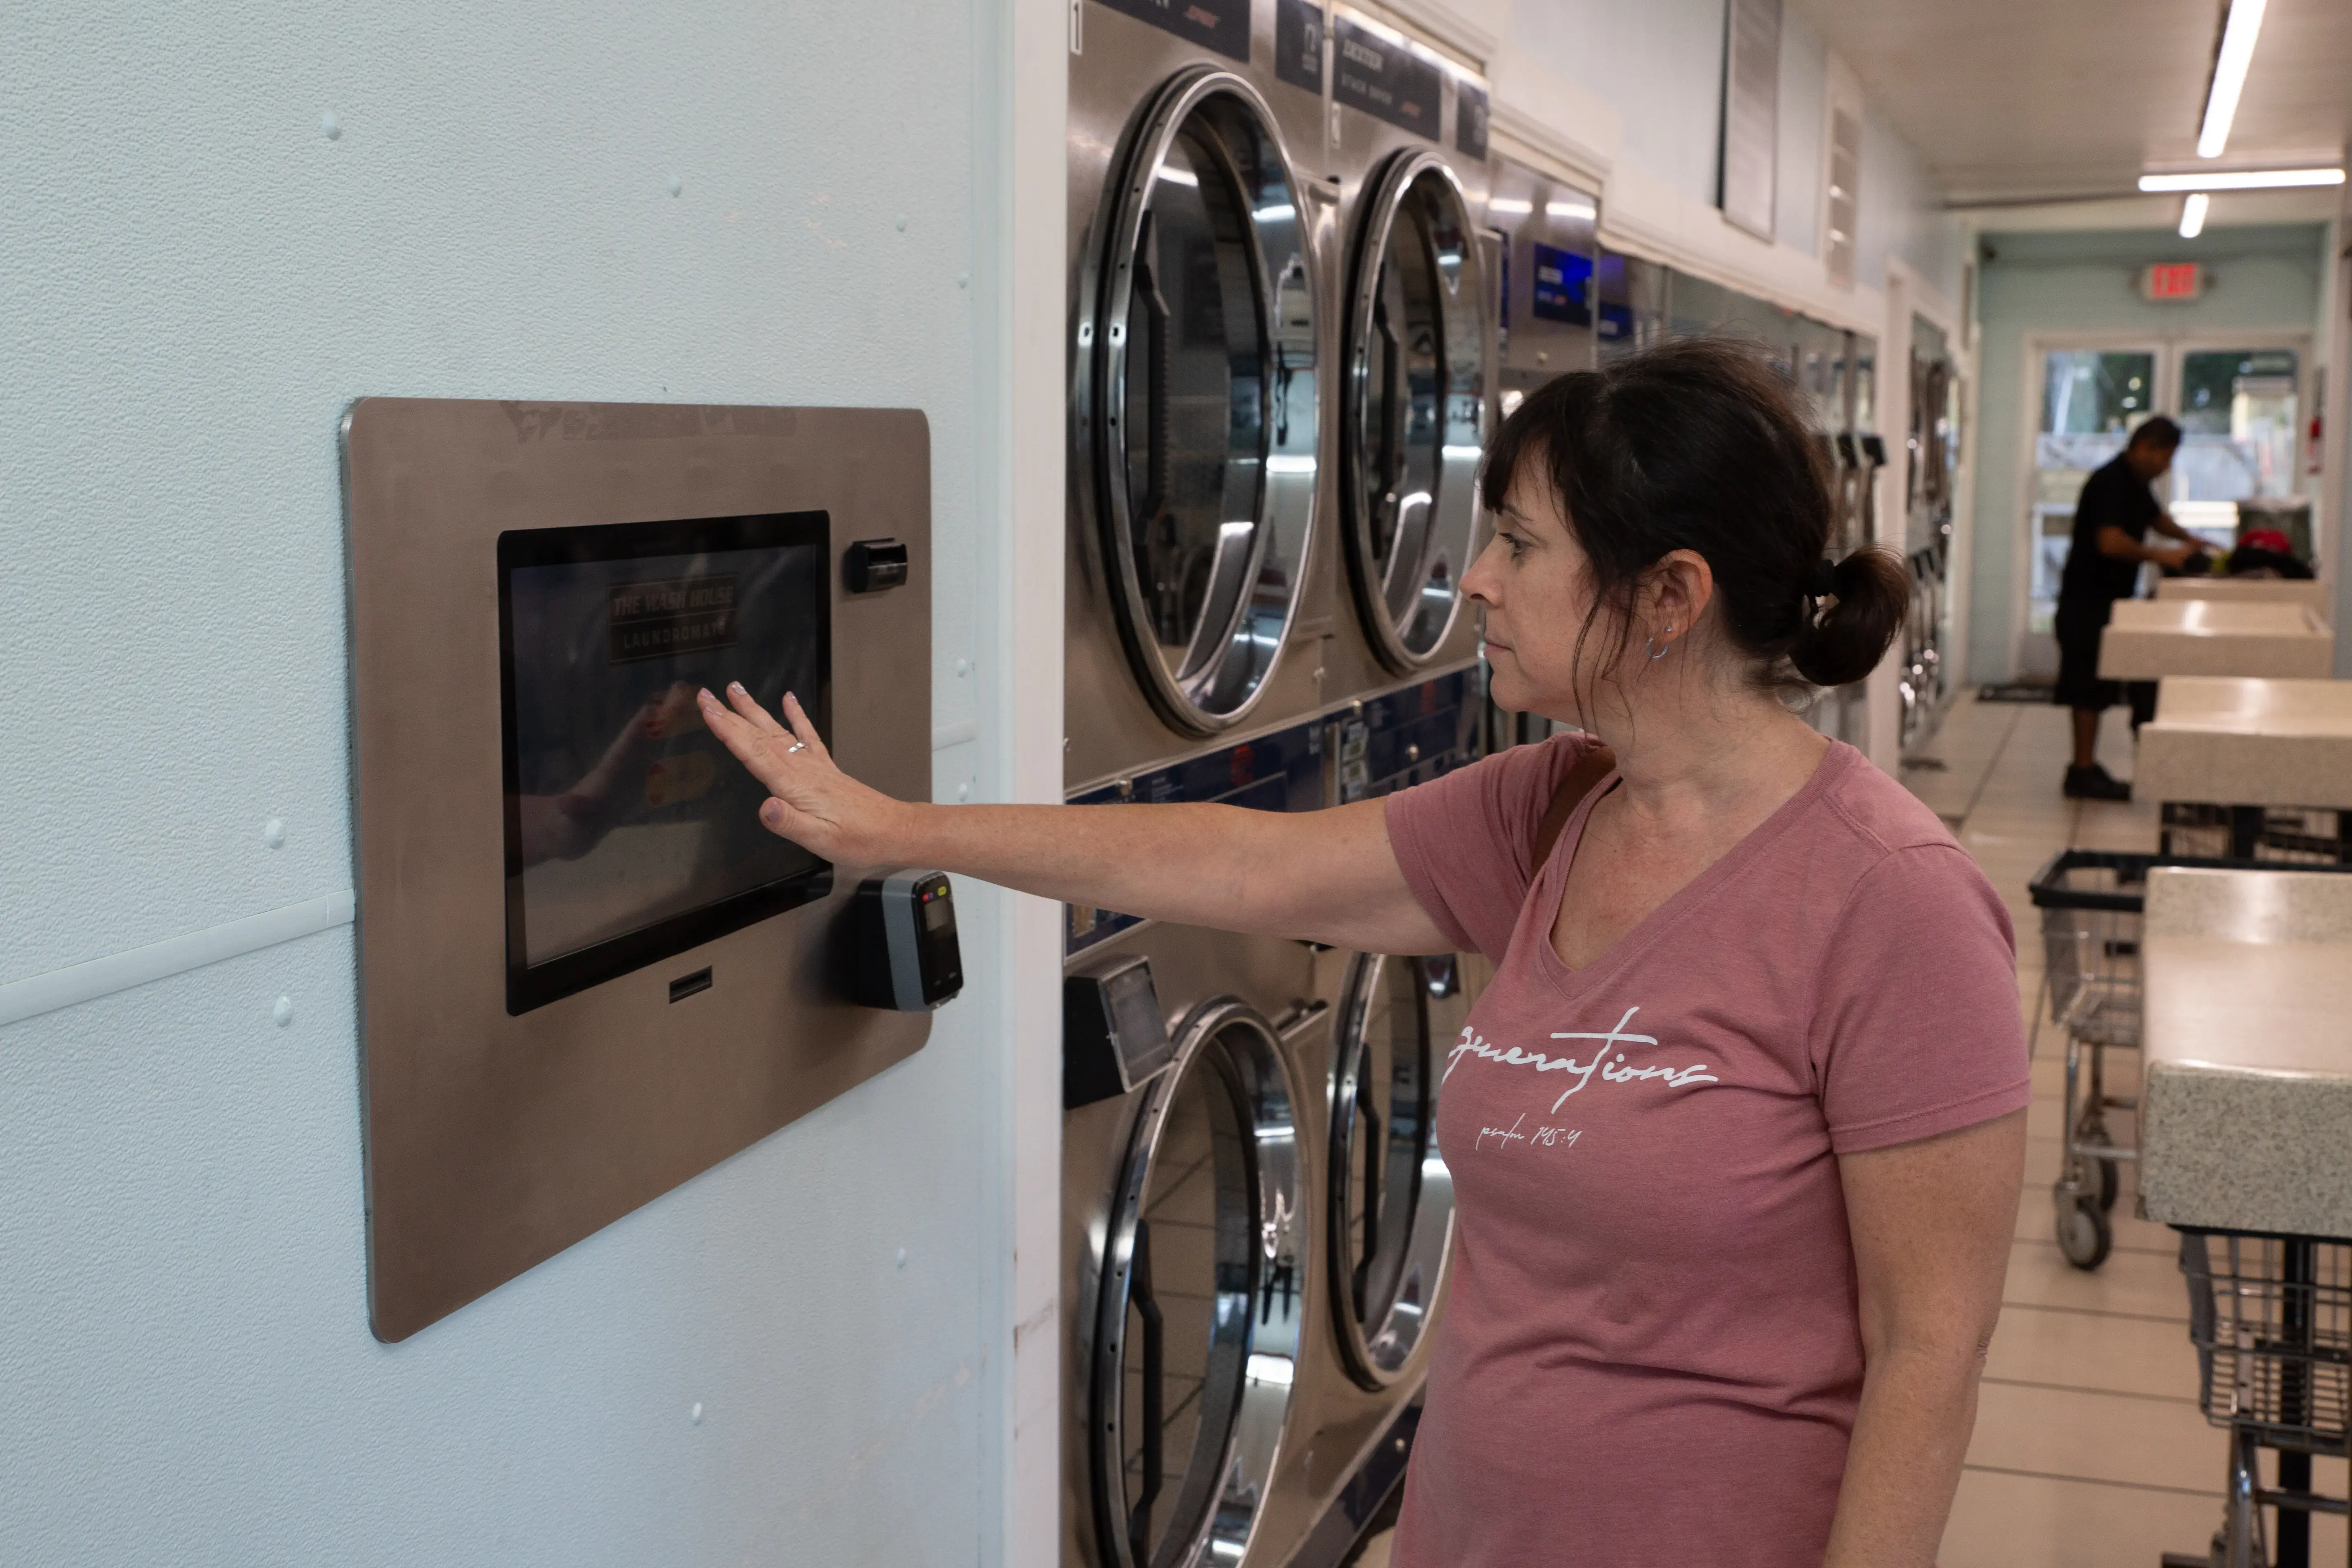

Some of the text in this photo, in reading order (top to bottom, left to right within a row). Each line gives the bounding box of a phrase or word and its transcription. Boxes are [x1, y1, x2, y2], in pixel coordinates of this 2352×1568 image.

[614, 595, 641, 616] THE
[1441, 1007, 1718, 1114] generations
[1476, 1113, 1582, 1151] psalm 145:4
